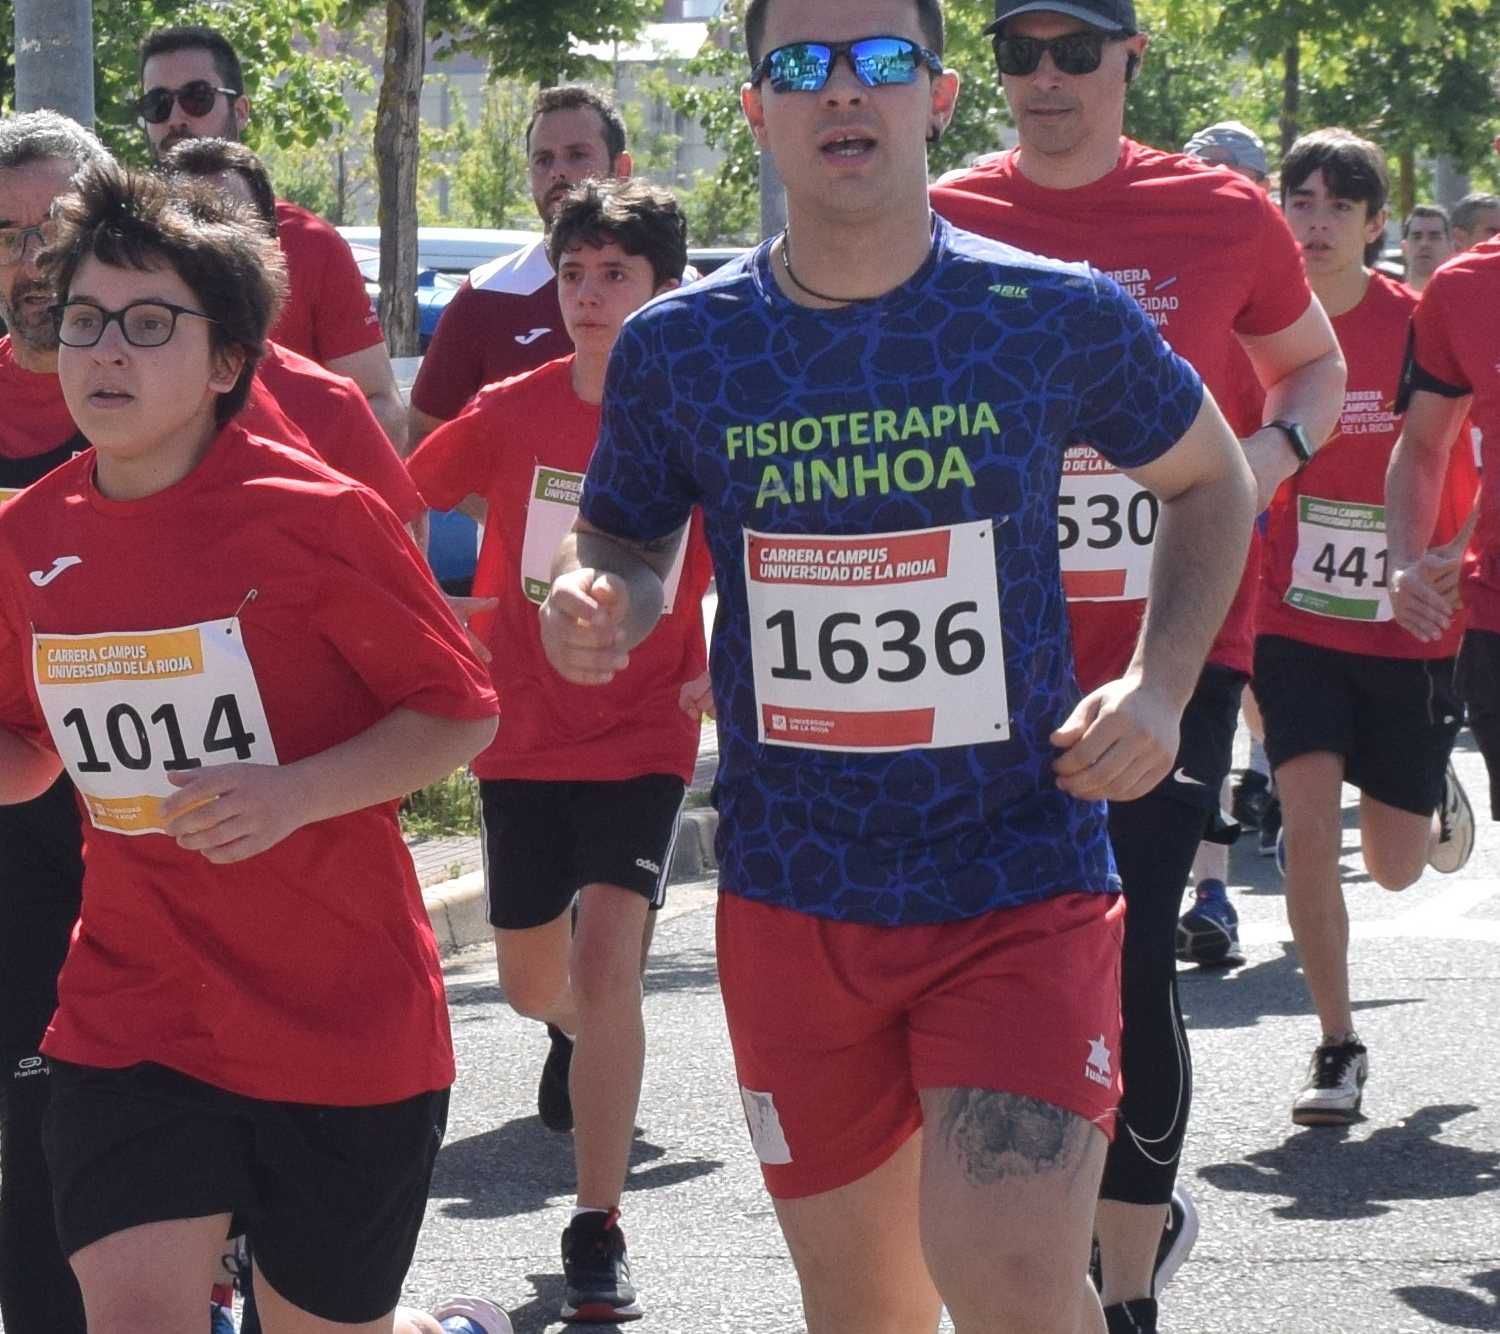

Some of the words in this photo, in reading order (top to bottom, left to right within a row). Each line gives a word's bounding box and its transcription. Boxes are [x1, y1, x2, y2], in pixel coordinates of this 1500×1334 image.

[1345, 391, 1383, 401] ARRERA
[1345, 402, 1380, 412] AMPUS
[726, 402, 1000, 460] FISIOTERAPIA
[1341, 424, 1354, 434] DE
[1355, 424, 1368, 434] LA
[1369, 422, 1394, 432] RIOJA
[1073, 460, 1087, 471] DE
[1088, 460, 1102, 470] LA
[756, 446, 976, 508] AINHOA
[544, 487, 580, 502] UNIVERS
[1308, 503, 1338, 515] CARRERA
[1339, 508, 1375, 519] CAMPUS
[760, 548, 824, 564] CARRERA
[826, 547, 888, 563] CAMPUS
[760, 563, 850, 581] UNIVERSIDAD
[852, 567, 872, 581] DE
[874, 565, 893, 580] LA
[896, 558, 936, 576] RIOJA
[766, 601, 985, 685] 1636
[48, 648, 97, 663] CARRERA
[99, 645, 147, 660] CAMPUS
[47, 662, 122, 679] UNIVERSIDAD
[123, 663, 138, 675] DE
[138, 662, 155, 675] LA
[155, 656, 193, 674] RIOJA
[62, 693, 256, 773] 1014
